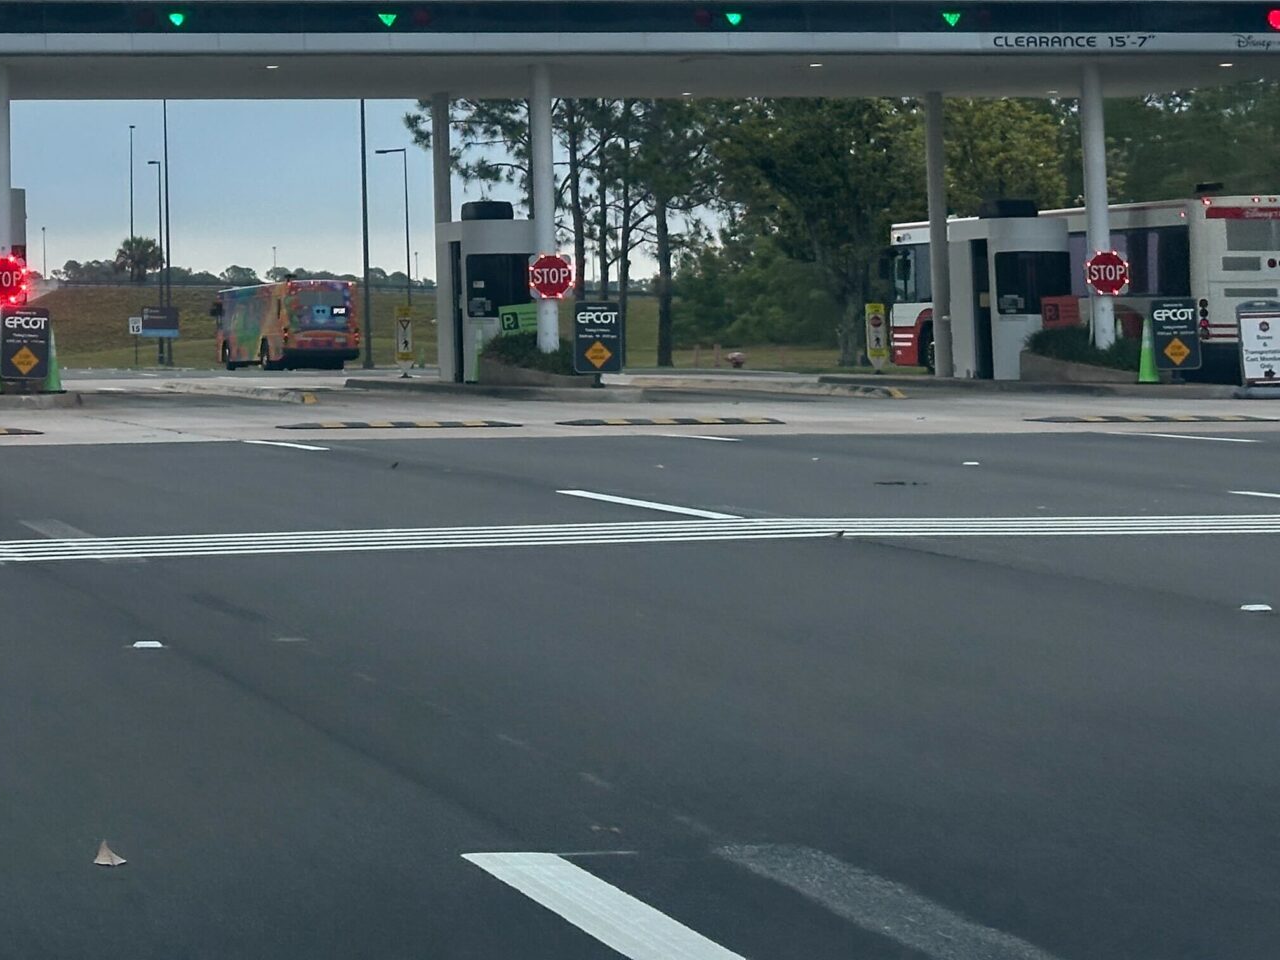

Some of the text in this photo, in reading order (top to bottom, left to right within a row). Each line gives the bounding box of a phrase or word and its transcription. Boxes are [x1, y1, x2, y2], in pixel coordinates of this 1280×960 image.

[993, 35, 1097, 48] CLEARANCE
[533, 268, 569, 284] STOP
[1090, 265, 1125, 281] STOP
[577, 311, 618, 324] EPCOT
[1153, 309, 1194, 321] EPCOT
[5, 316, 48, 329] EPCOT
